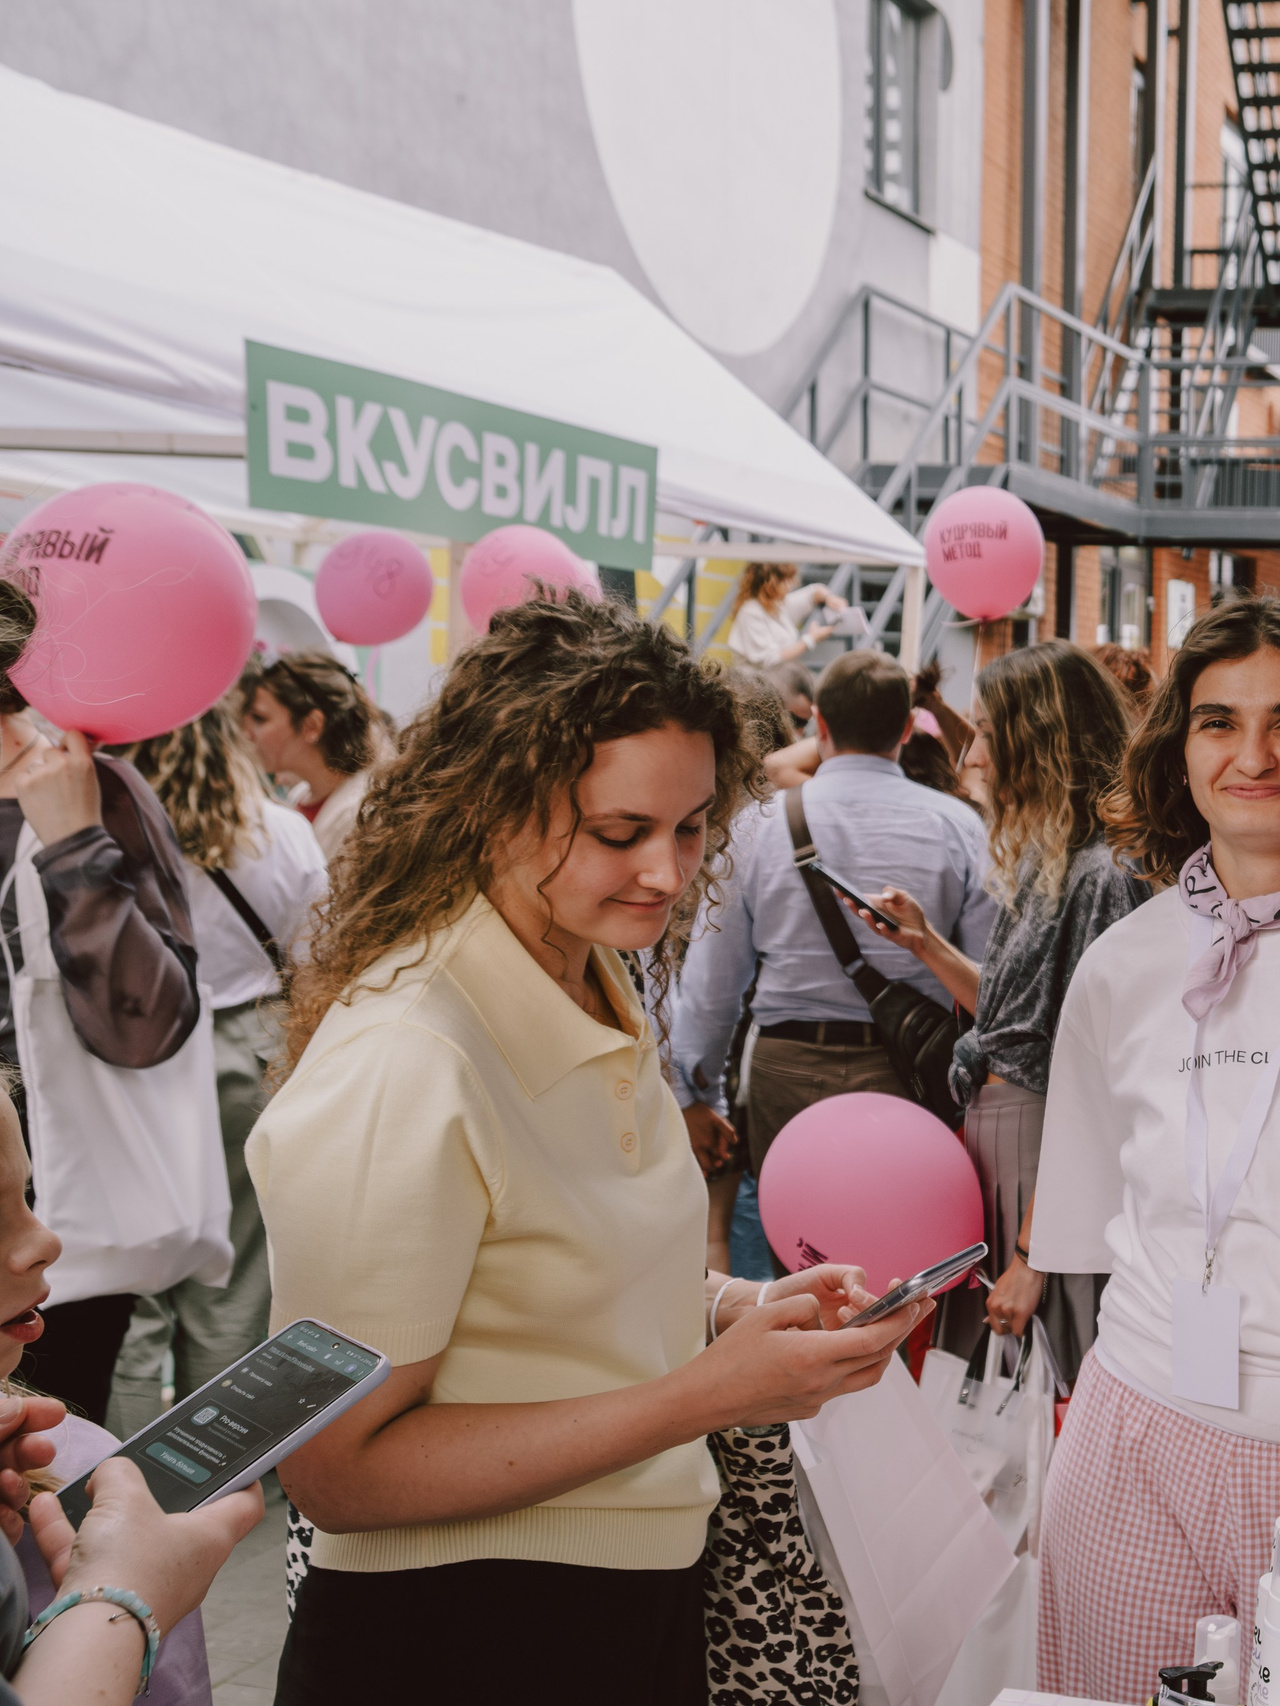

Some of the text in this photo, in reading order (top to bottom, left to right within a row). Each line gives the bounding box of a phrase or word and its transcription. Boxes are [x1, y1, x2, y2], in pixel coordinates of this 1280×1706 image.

[265, 379, 648, 544] ВКУСВИЛЛ
[939, 520, 1008, 545] КУДРЯВЫЙ
[942, 541, 983, 563] МЕТОД
[1178, 1053, 1211, 1073] JOIN
[1214, 1050, 1247, 1065] THE
